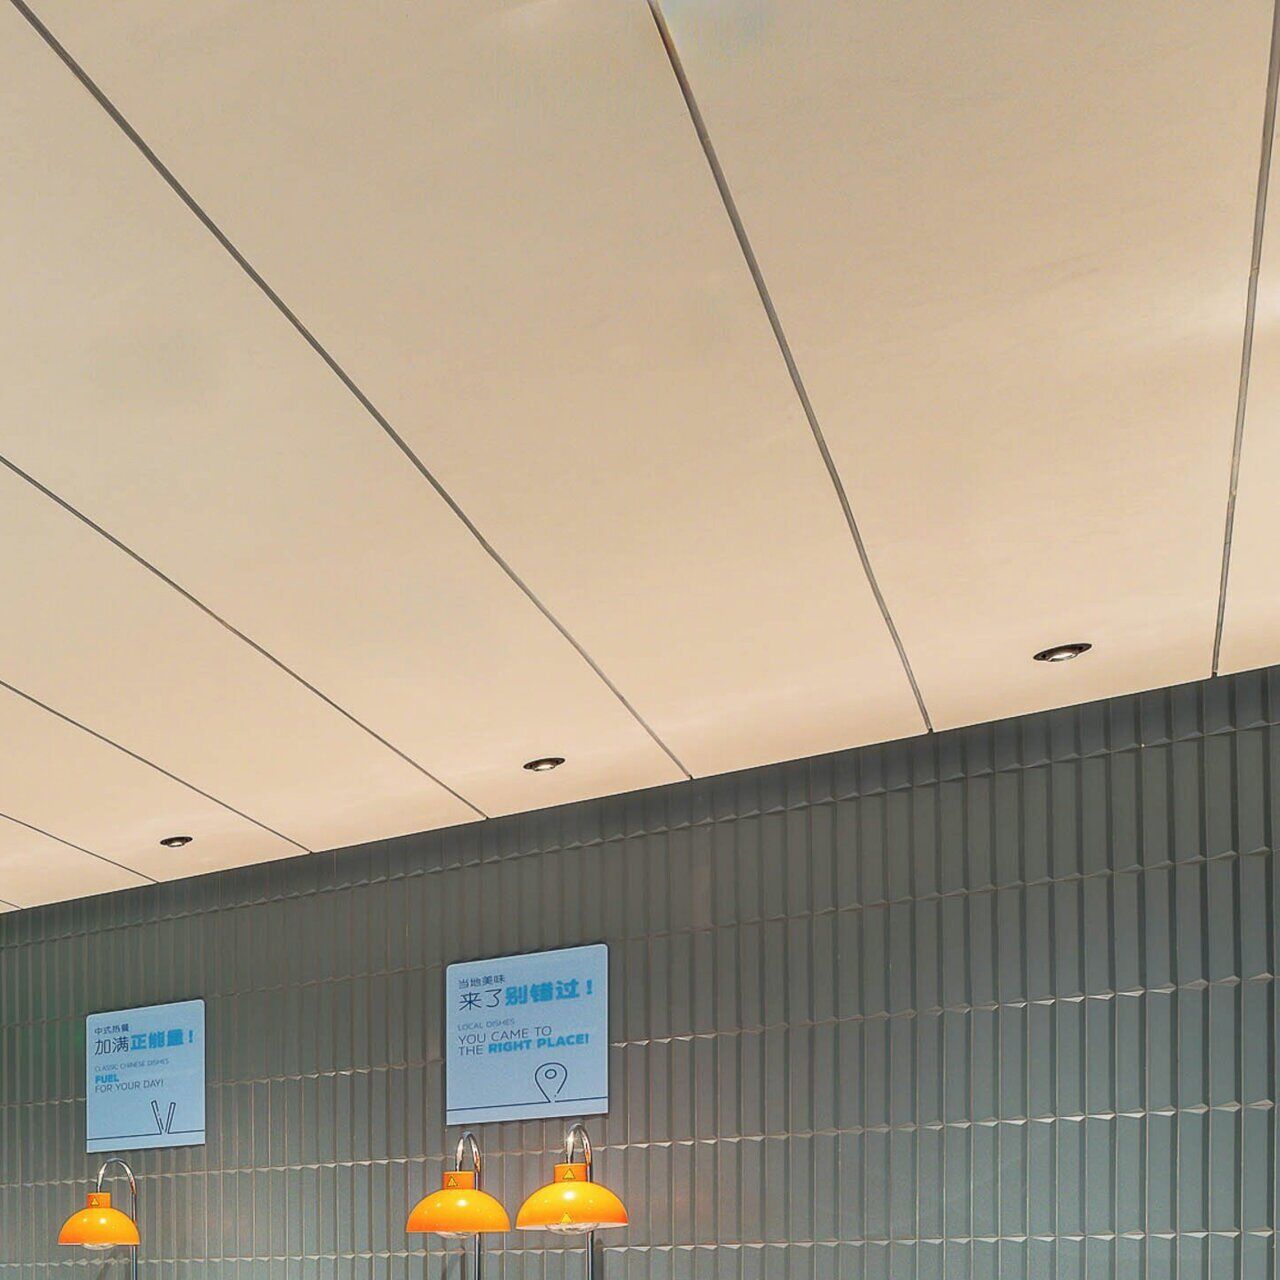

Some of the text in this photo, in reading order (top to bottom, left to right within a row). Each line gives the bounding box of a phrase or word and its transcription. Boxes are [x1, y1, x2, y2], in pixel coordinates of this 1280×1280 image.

[458, 974, 505, 989] 当地美味
[457, 1021, 483, 1031] LOCAL
[458, 1025, 552, 1045] YOU CAME TO
[458, 1033, 590, 1056] THE RIGHT PLACE!
[95, 1074, 119, 1084] FUEL
[95, 1078, 164, 1093] FOR YOUR DAY!
